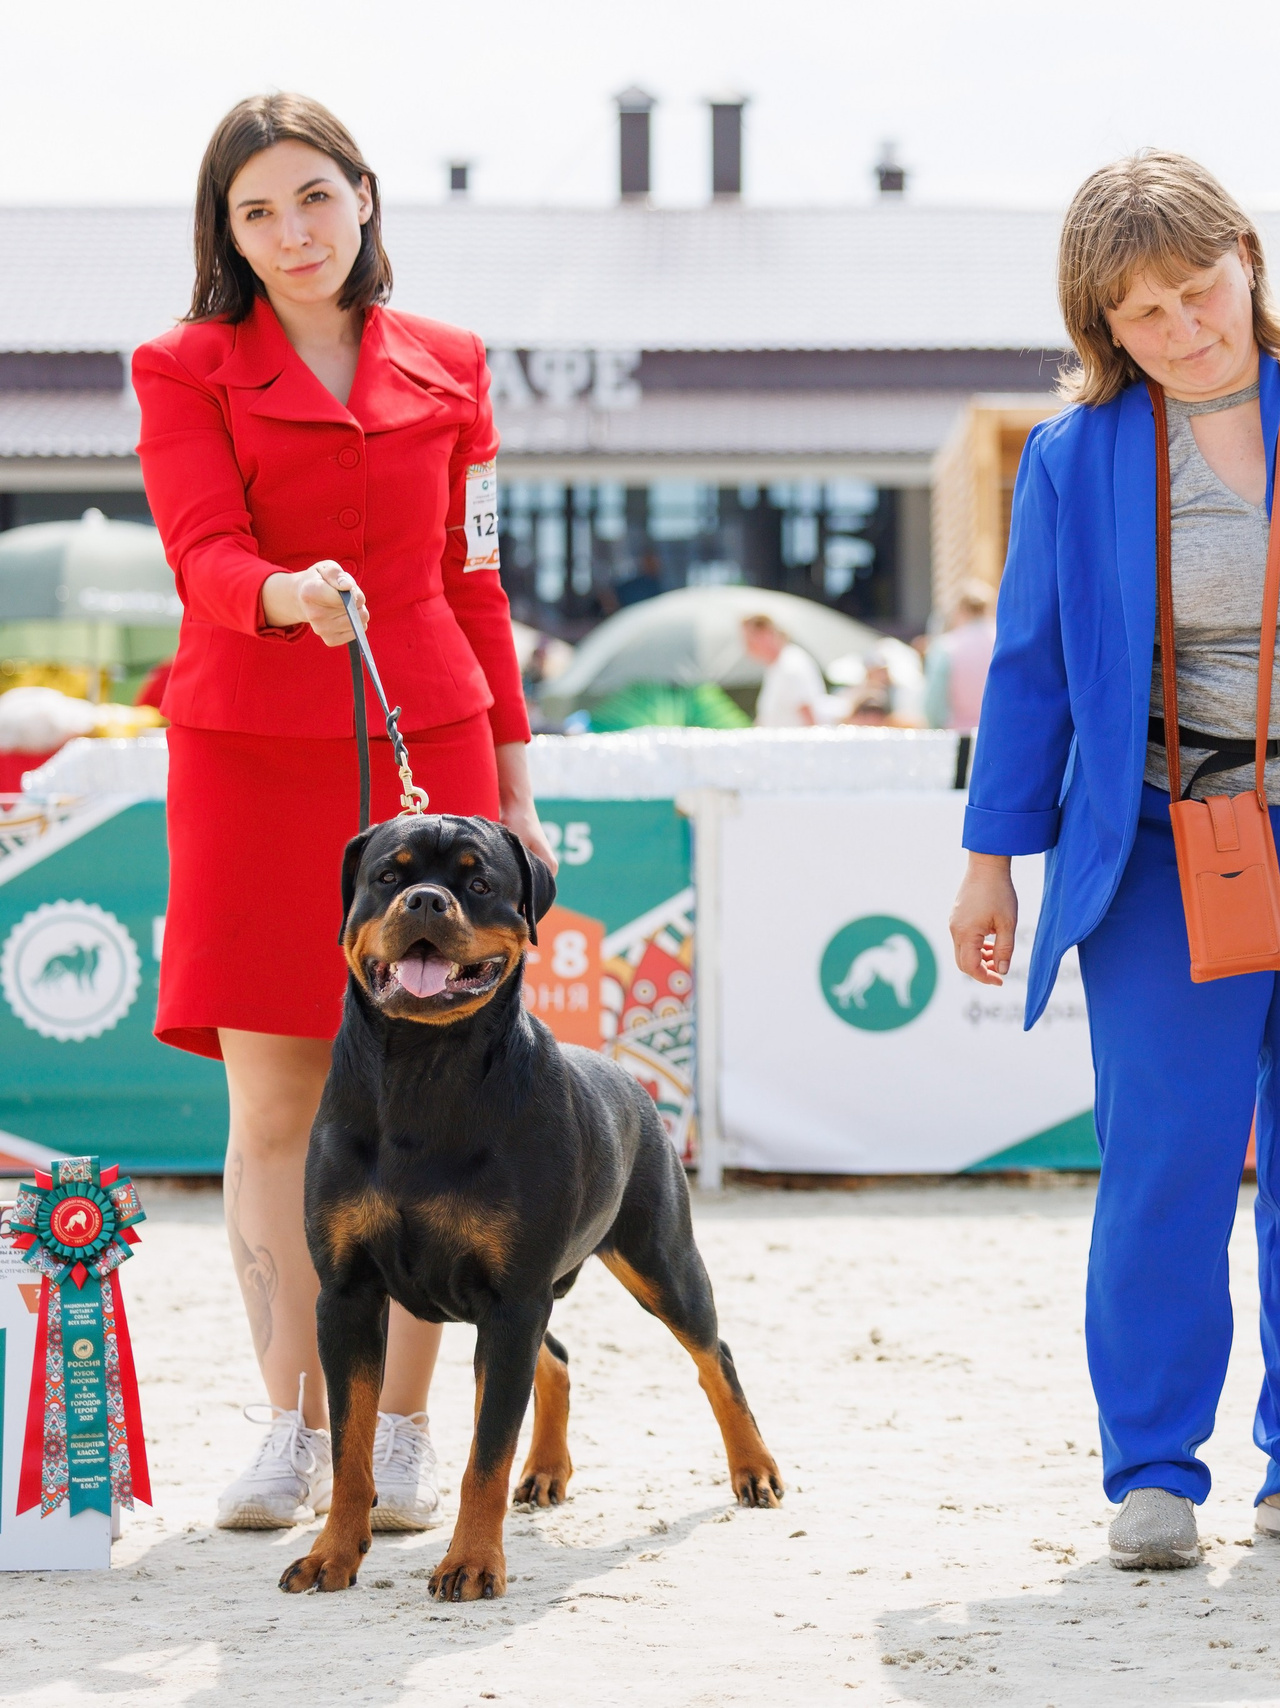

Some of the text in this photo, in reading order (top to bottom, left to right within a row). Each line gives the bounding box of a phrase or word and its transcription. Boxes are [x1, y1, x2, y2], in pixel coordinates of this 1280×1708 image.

[488, 345, 643, 408] АФЕ
[541, 820, 594, 866] 25
[67, 1360, 101, 1368] РОССИЯ
[79, 1414, 94, 1422] 2025
[71, 1441, 106, 1449] ПОБЕДИТЕЛЬ
